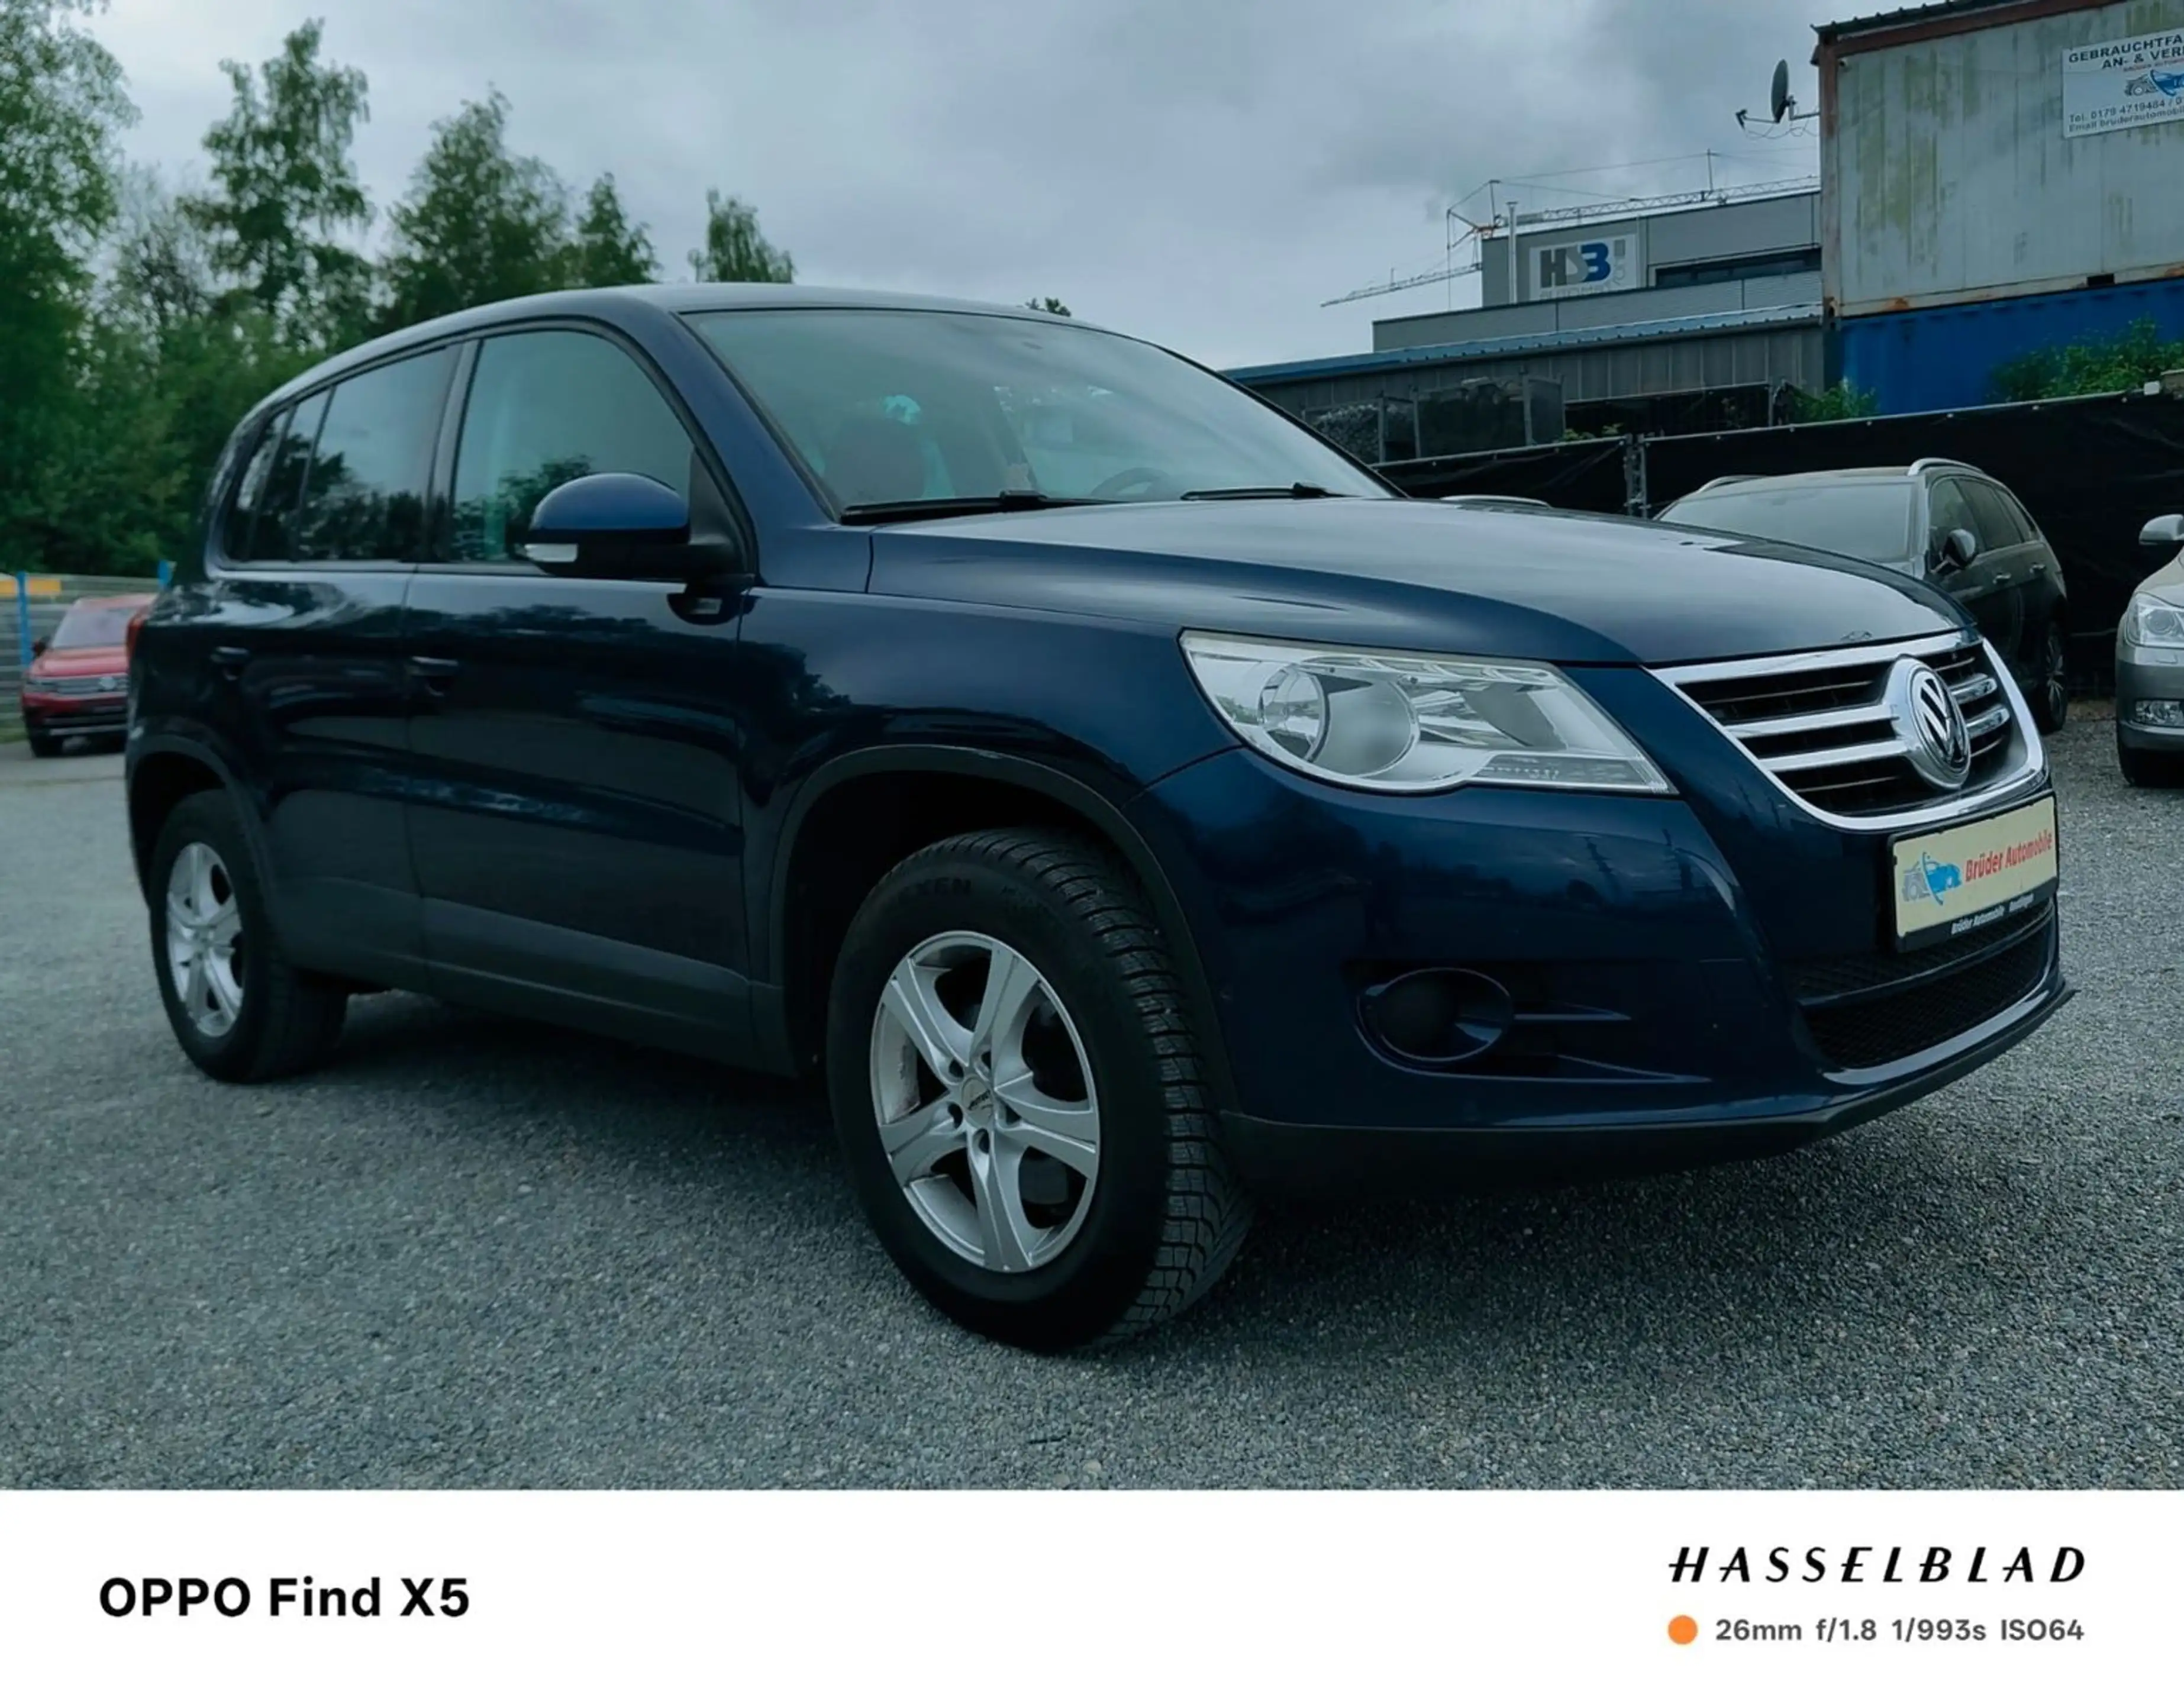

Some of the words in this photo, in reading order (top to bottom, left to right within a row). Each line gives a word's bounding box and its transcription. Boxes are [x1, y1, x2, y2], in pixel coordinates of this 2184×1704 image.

[2069, 34, 2183, 63] GEBRAUCHTFA
[2102, 57, 2128, 69] AN-
[2134, 53, 2144, 63] &
[2150, 46, 2184, 60] VER
[1965, 851, 2003, 882] Brüder
